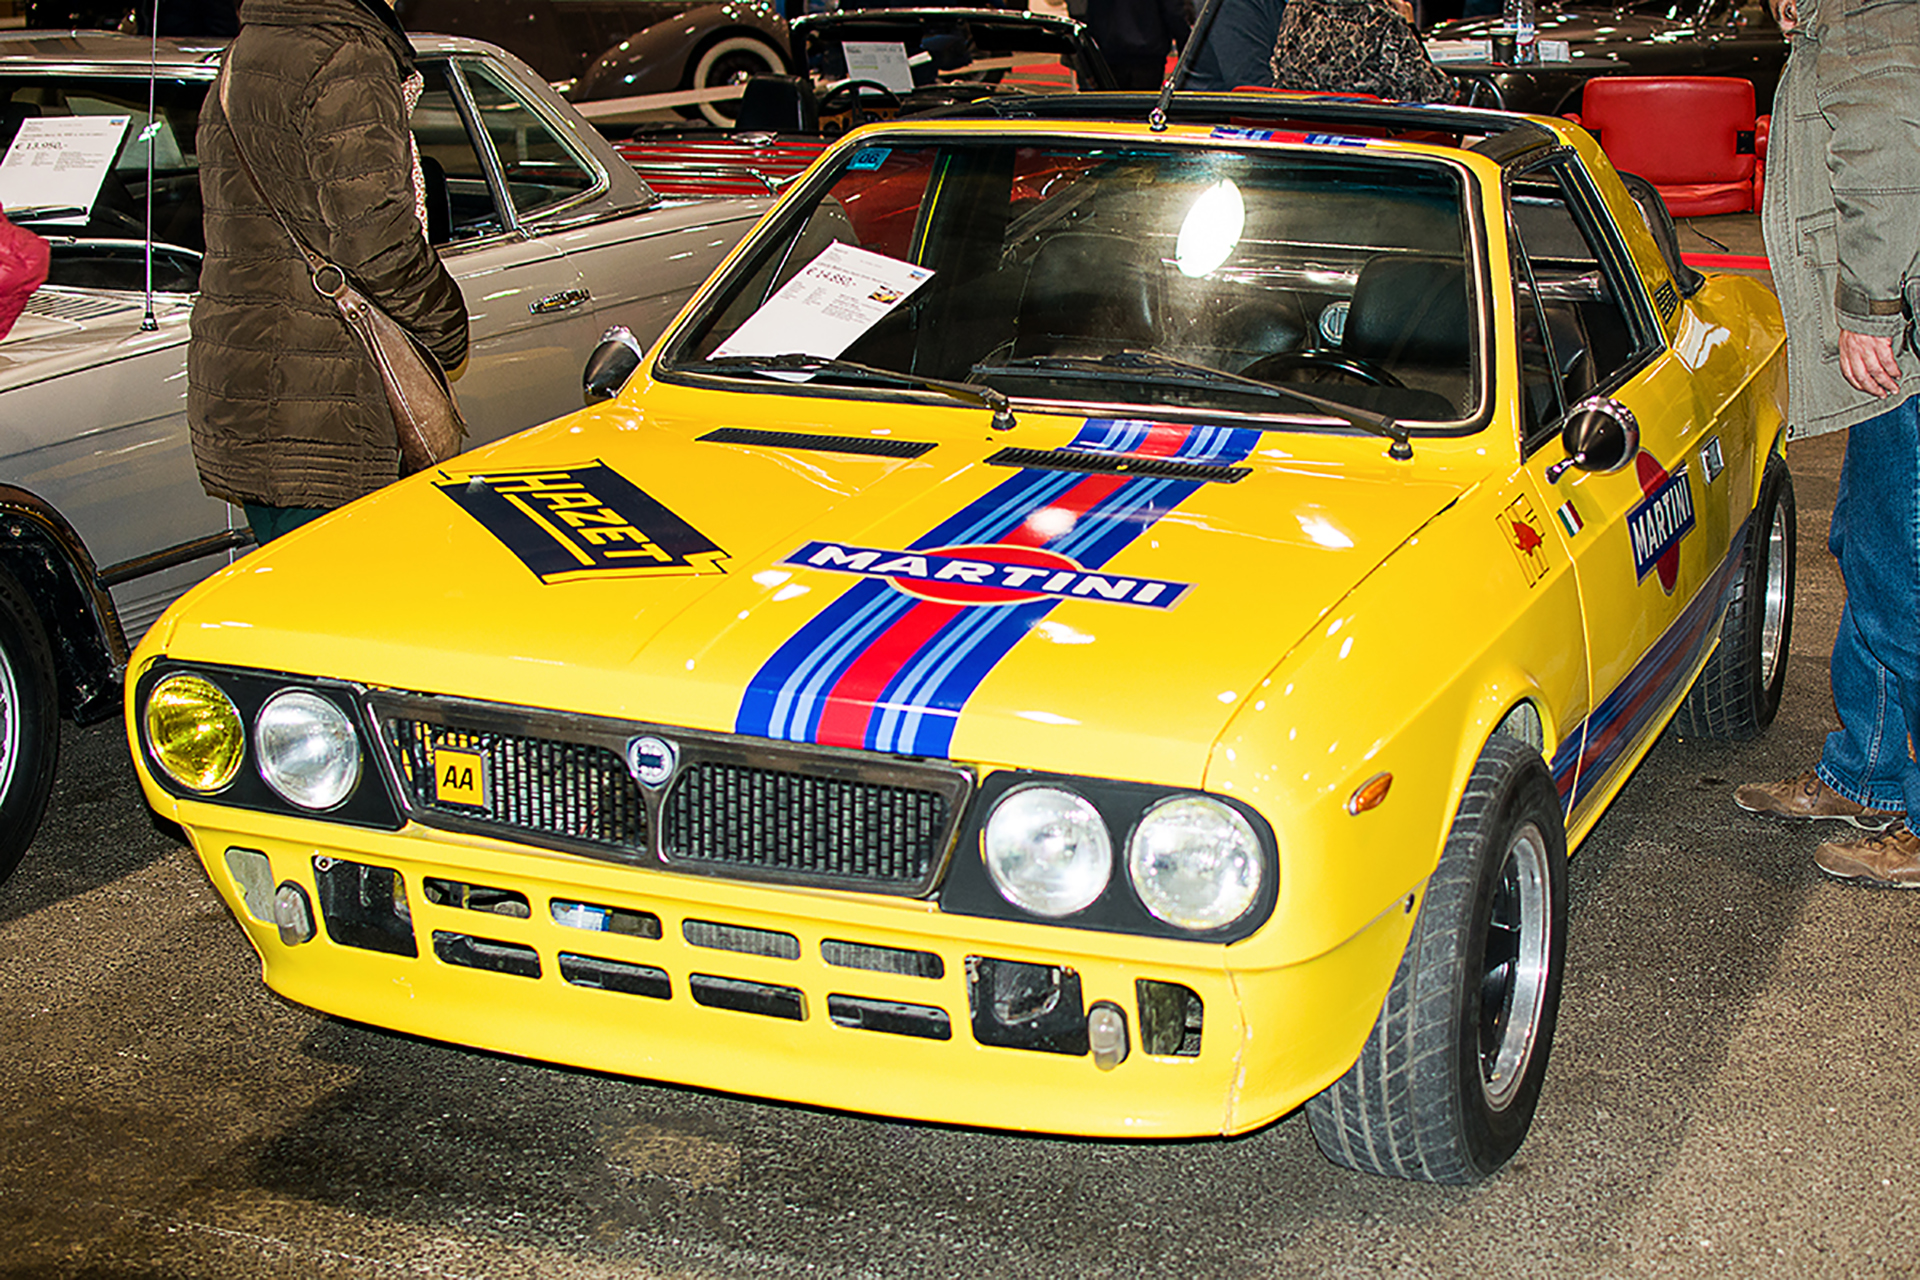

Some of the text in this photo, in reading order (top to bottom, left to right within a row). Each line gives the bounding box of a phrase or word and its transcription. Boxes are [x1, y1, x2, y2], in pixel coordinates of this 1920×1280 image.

[482, 472, 673, 564] HAZET
[1632, 476, 1693, 566] MARTINI
[807, 545, 1168, 604] MARTINI
[442, 765, 474, 792] AA
